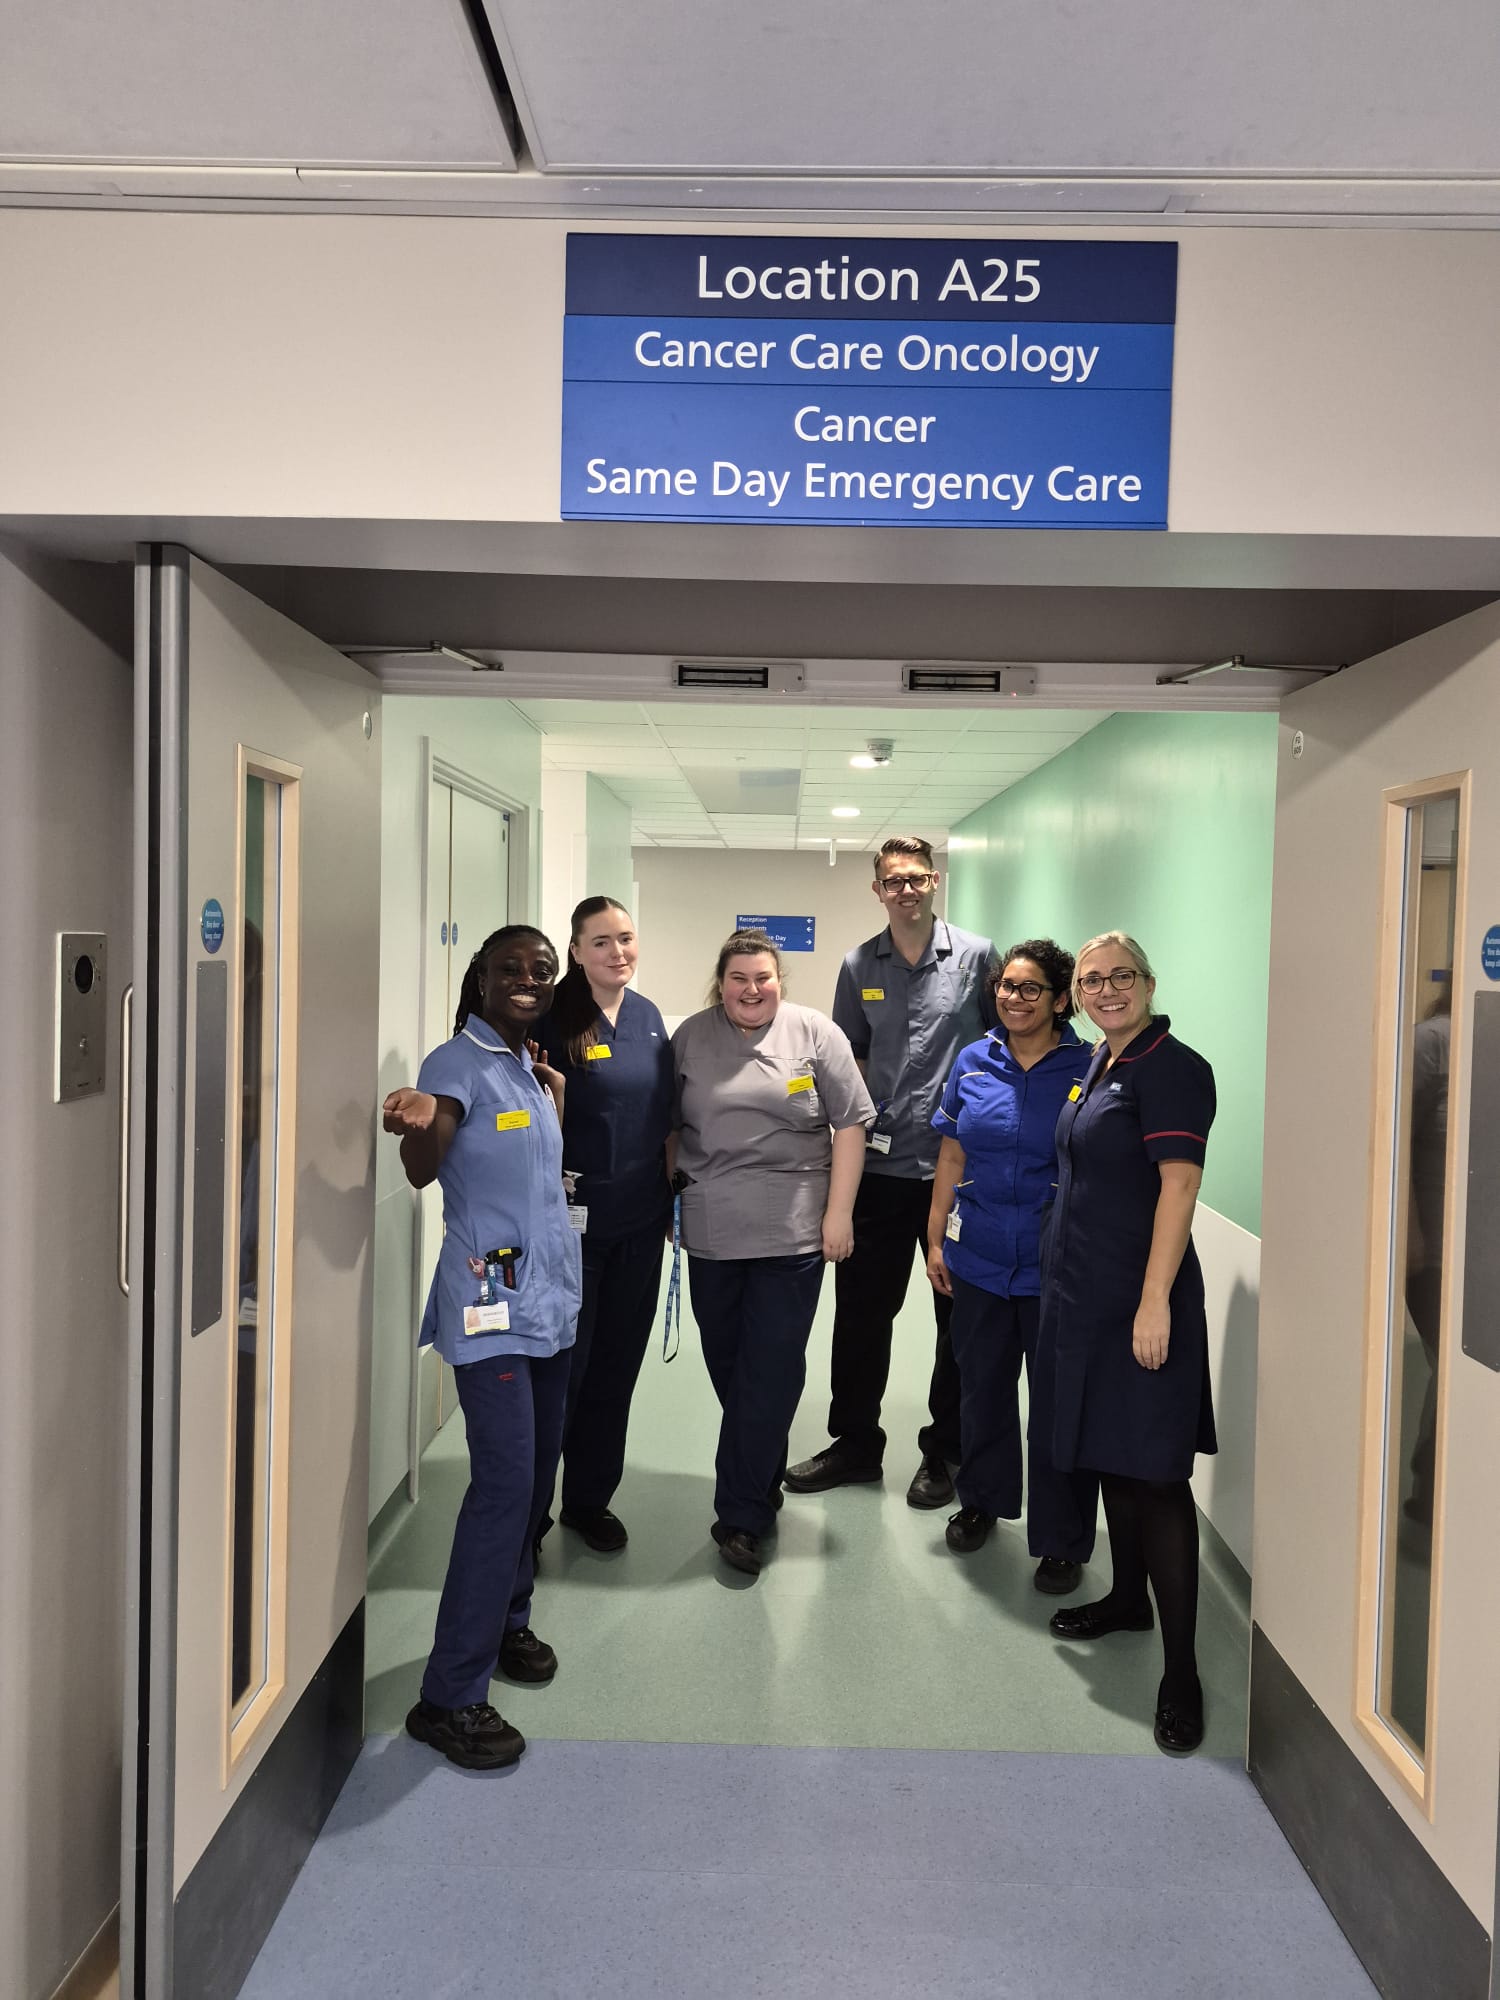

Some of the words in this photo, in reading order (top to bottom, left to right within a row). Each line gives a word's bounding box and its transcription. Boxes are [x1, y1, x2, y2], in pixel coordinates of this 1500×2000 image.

[698, 255, 919, 302] Location
[938, 258, 1041, 303] A25
[634, 330, 777, 369] Cancer
[790, 333, 884, 371] Care
[898, 334, 1100, 383] Oncology
[794, 405, 937, 443] Cancer
[586, 458, 698, 496] Same
[711, 460, 791, 508] Day
[805, 462, 1035, 511] Emergency
[1047, 465, 1142, 502] Care
